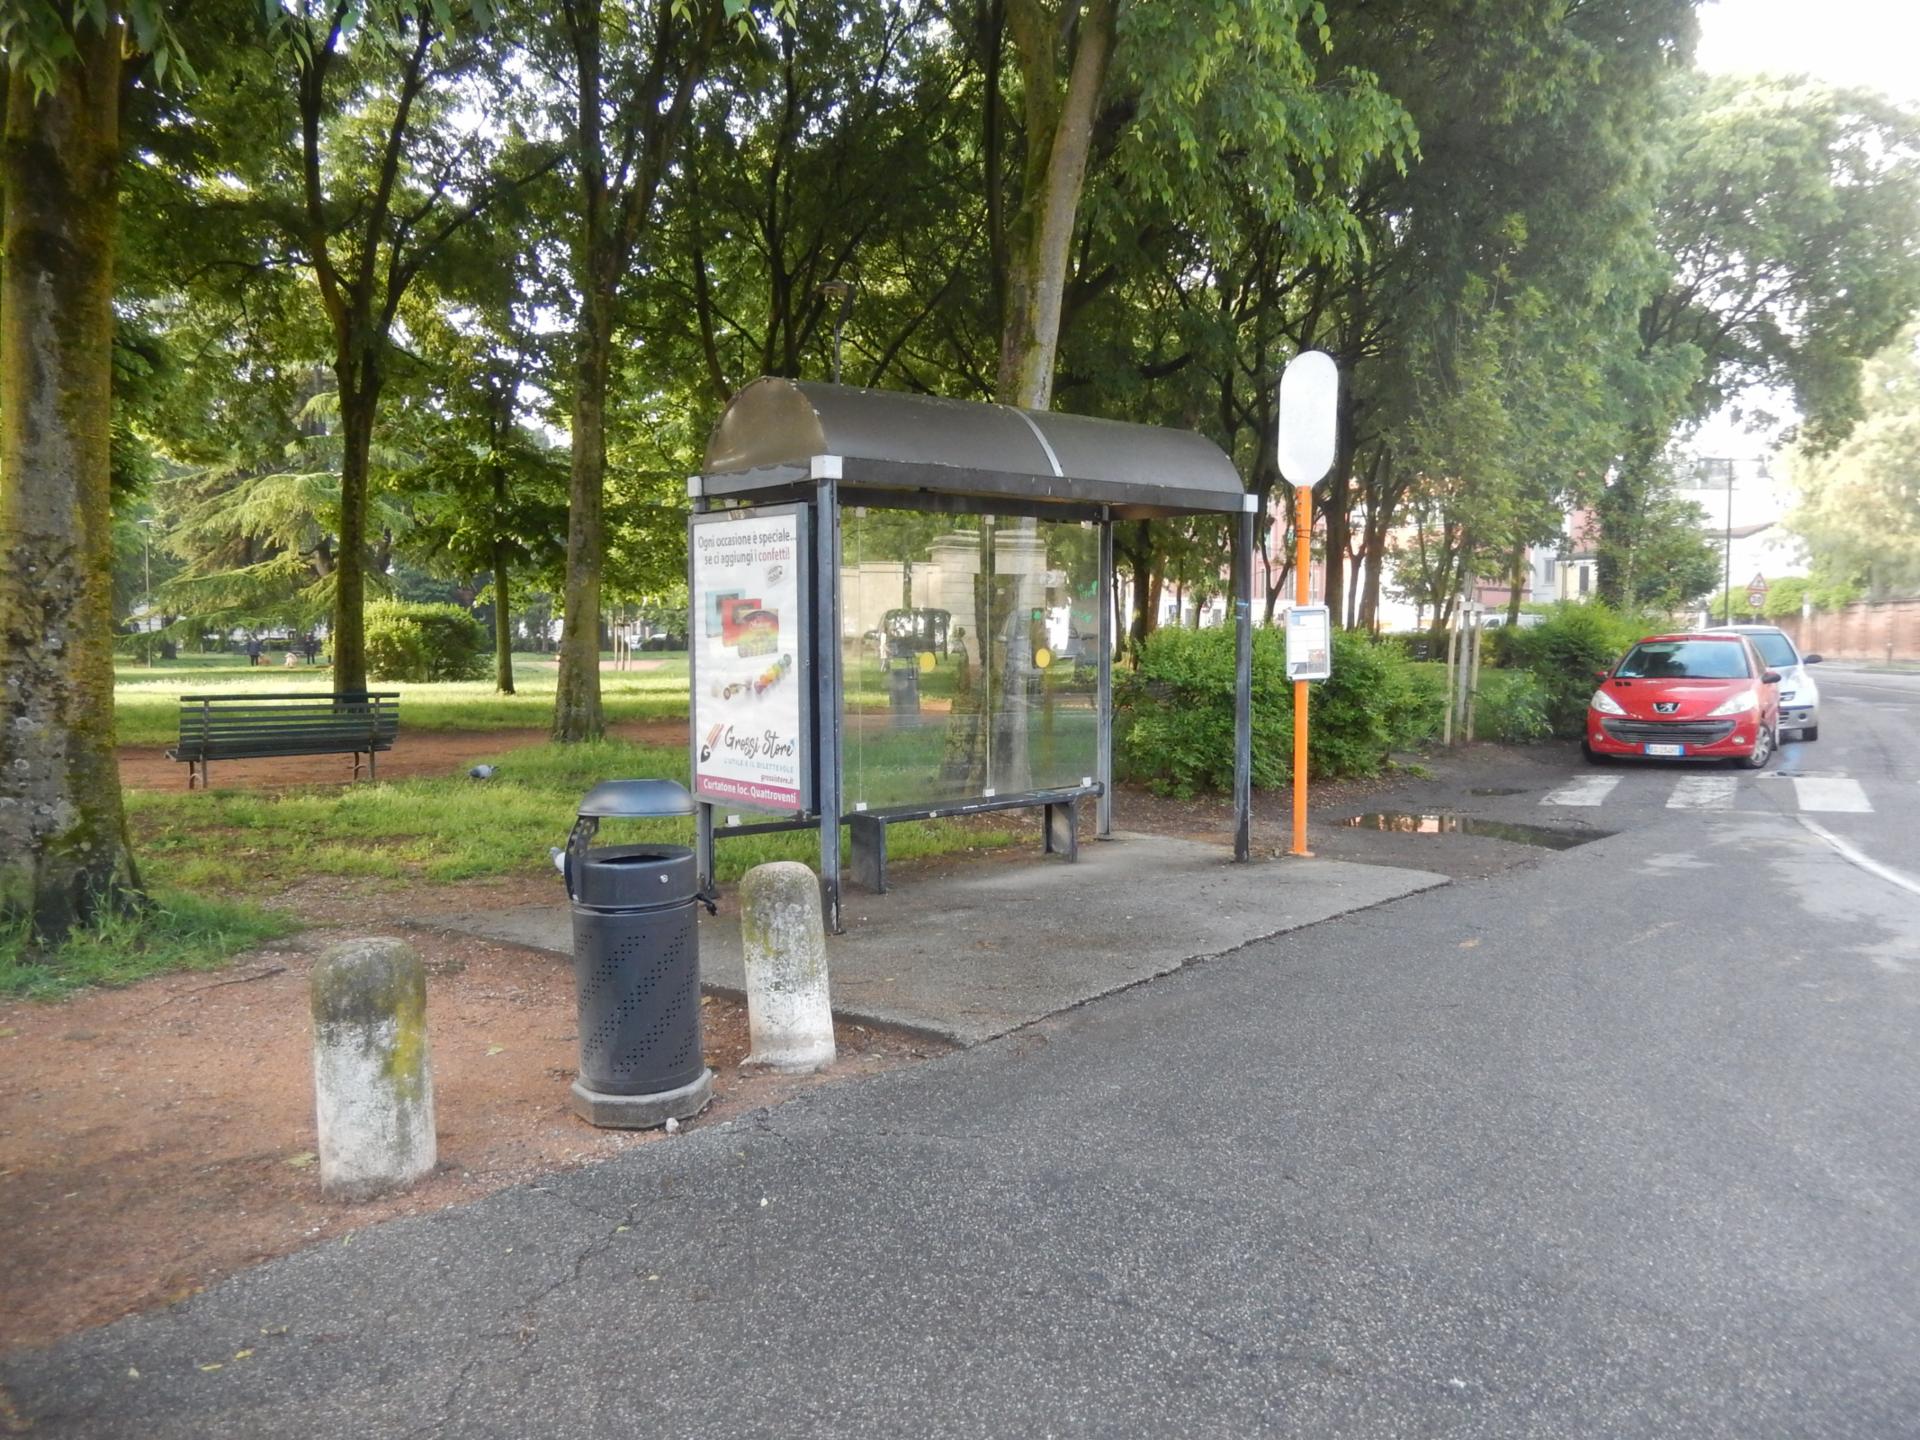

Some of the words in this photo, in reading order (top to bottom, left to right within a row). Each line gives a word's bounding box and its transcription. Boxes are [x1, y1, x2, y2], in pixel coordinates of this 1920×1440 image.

[698, 534, 715, 551] Ogni
[716, 532, 751, 547] occasione
[753, 530, 758, 544] è
[705, 555, 712, 565] se
[714, 552, 719, 564] ci
[721, 549, 753, 567] aggiungi
[758, 547, 790, 562] confetti!
[724, 725, 760, 759] Grossi
[762, 730, 794, 758] Store
[704, 778, 736, 793] Curtatone
[737, 783, 749, 795] loc.
[750, 786, 796, 803] Quattroventi
